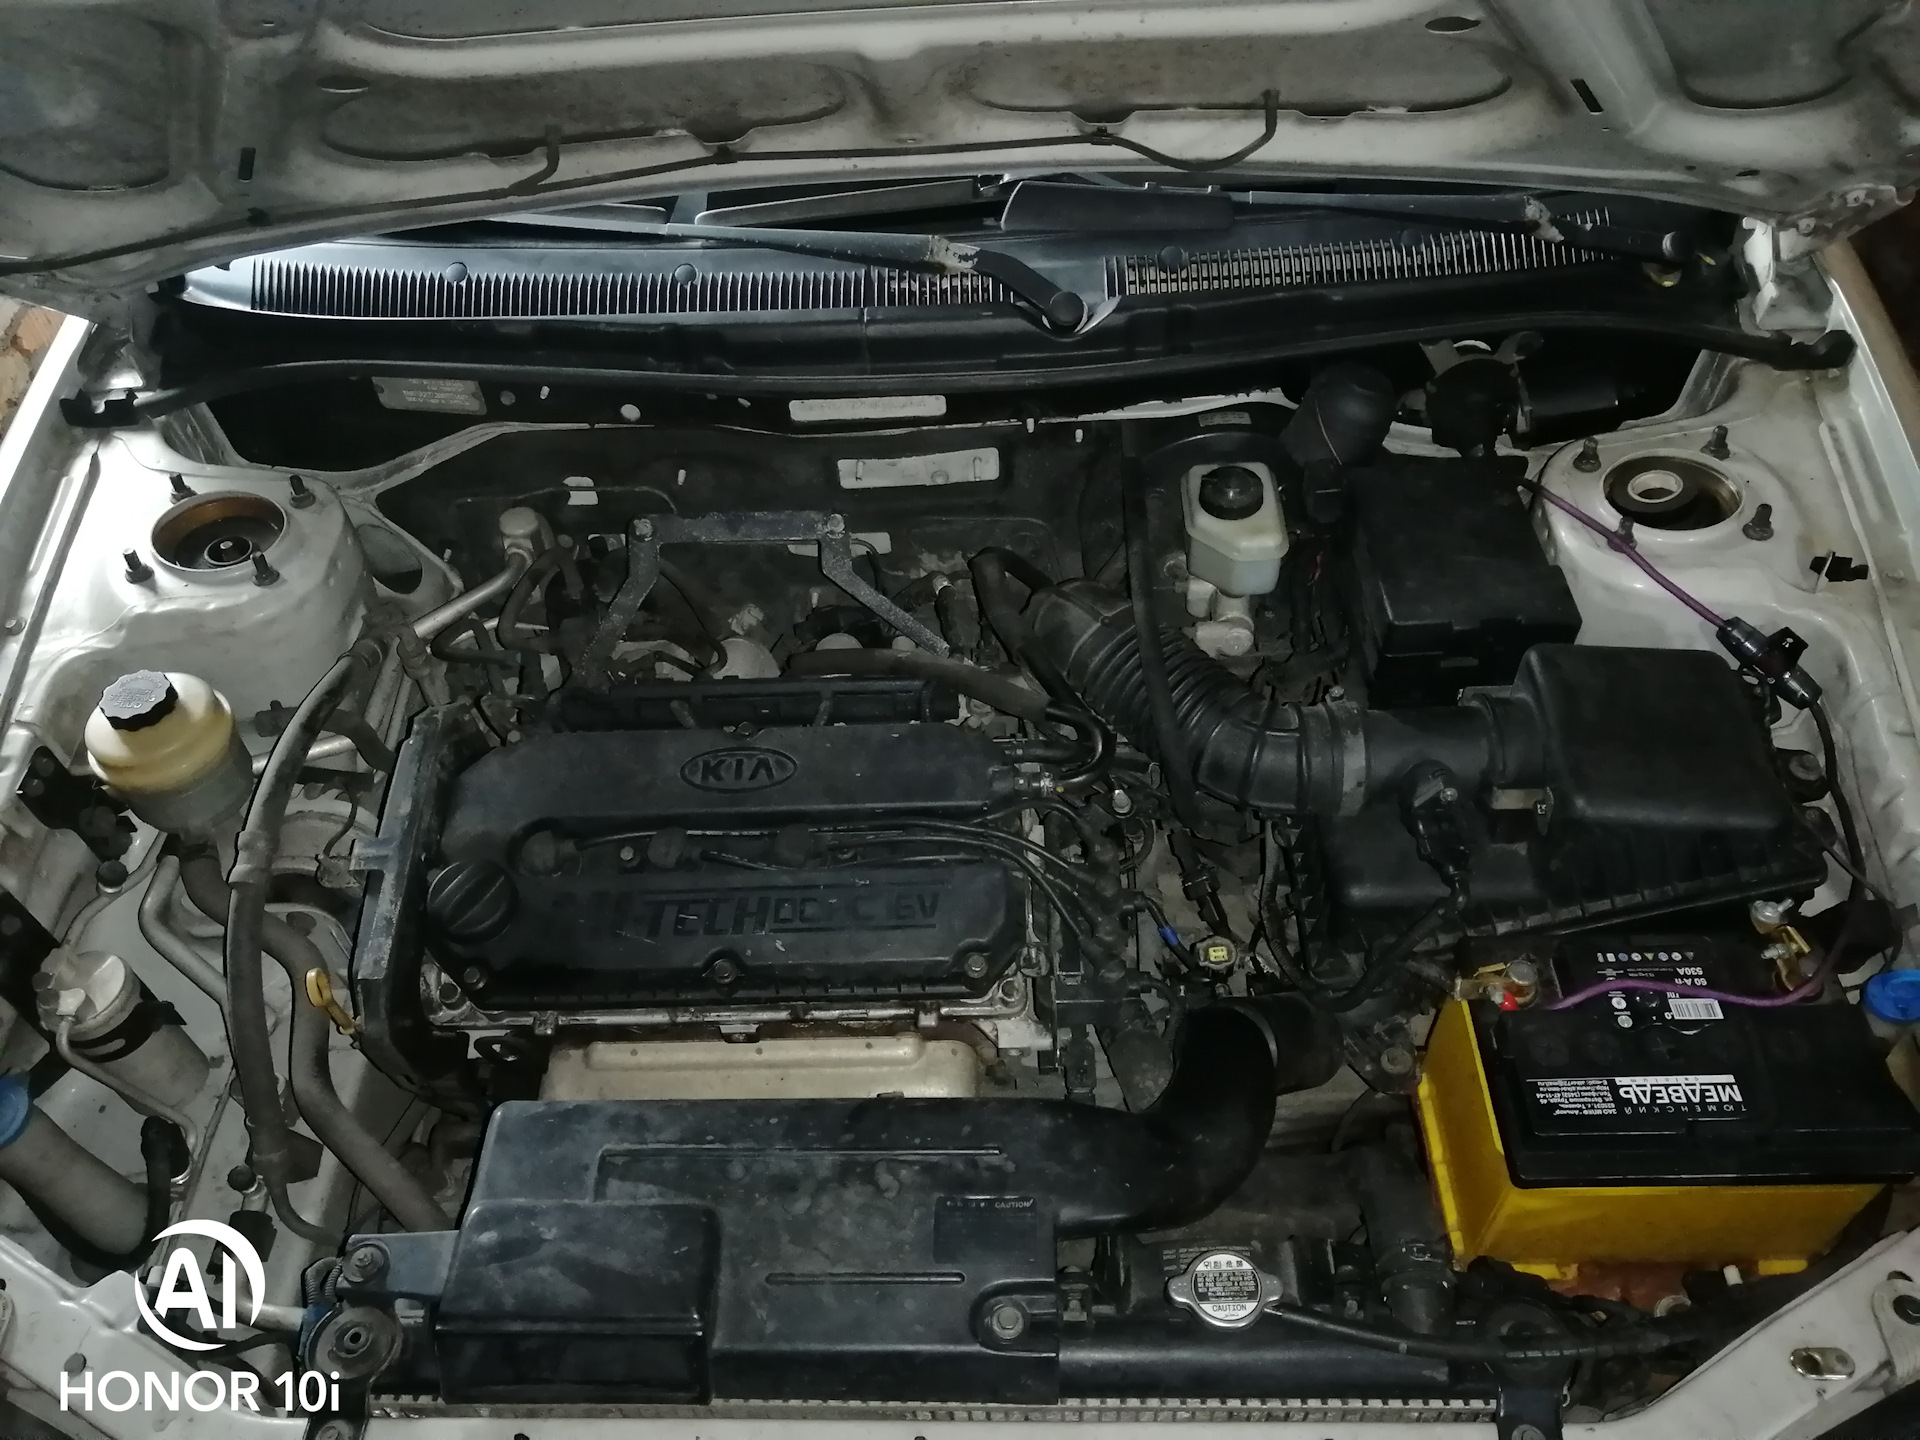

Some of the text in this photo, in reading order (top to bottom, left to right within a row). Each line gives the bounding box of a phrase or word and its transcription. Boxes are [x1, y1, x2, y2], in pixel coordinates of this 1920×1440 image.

[701, 758, 775, 781] KIA
[1618, 1082, 1743, 1104] МЕДВЕДЬ
[1624, 1104, 1747, 1114] ТЮМЕНСКИЙ
[994, 1201, 1030, 1209] CAUTION
[1212, 1304, 1247, 1313] CAUTION
